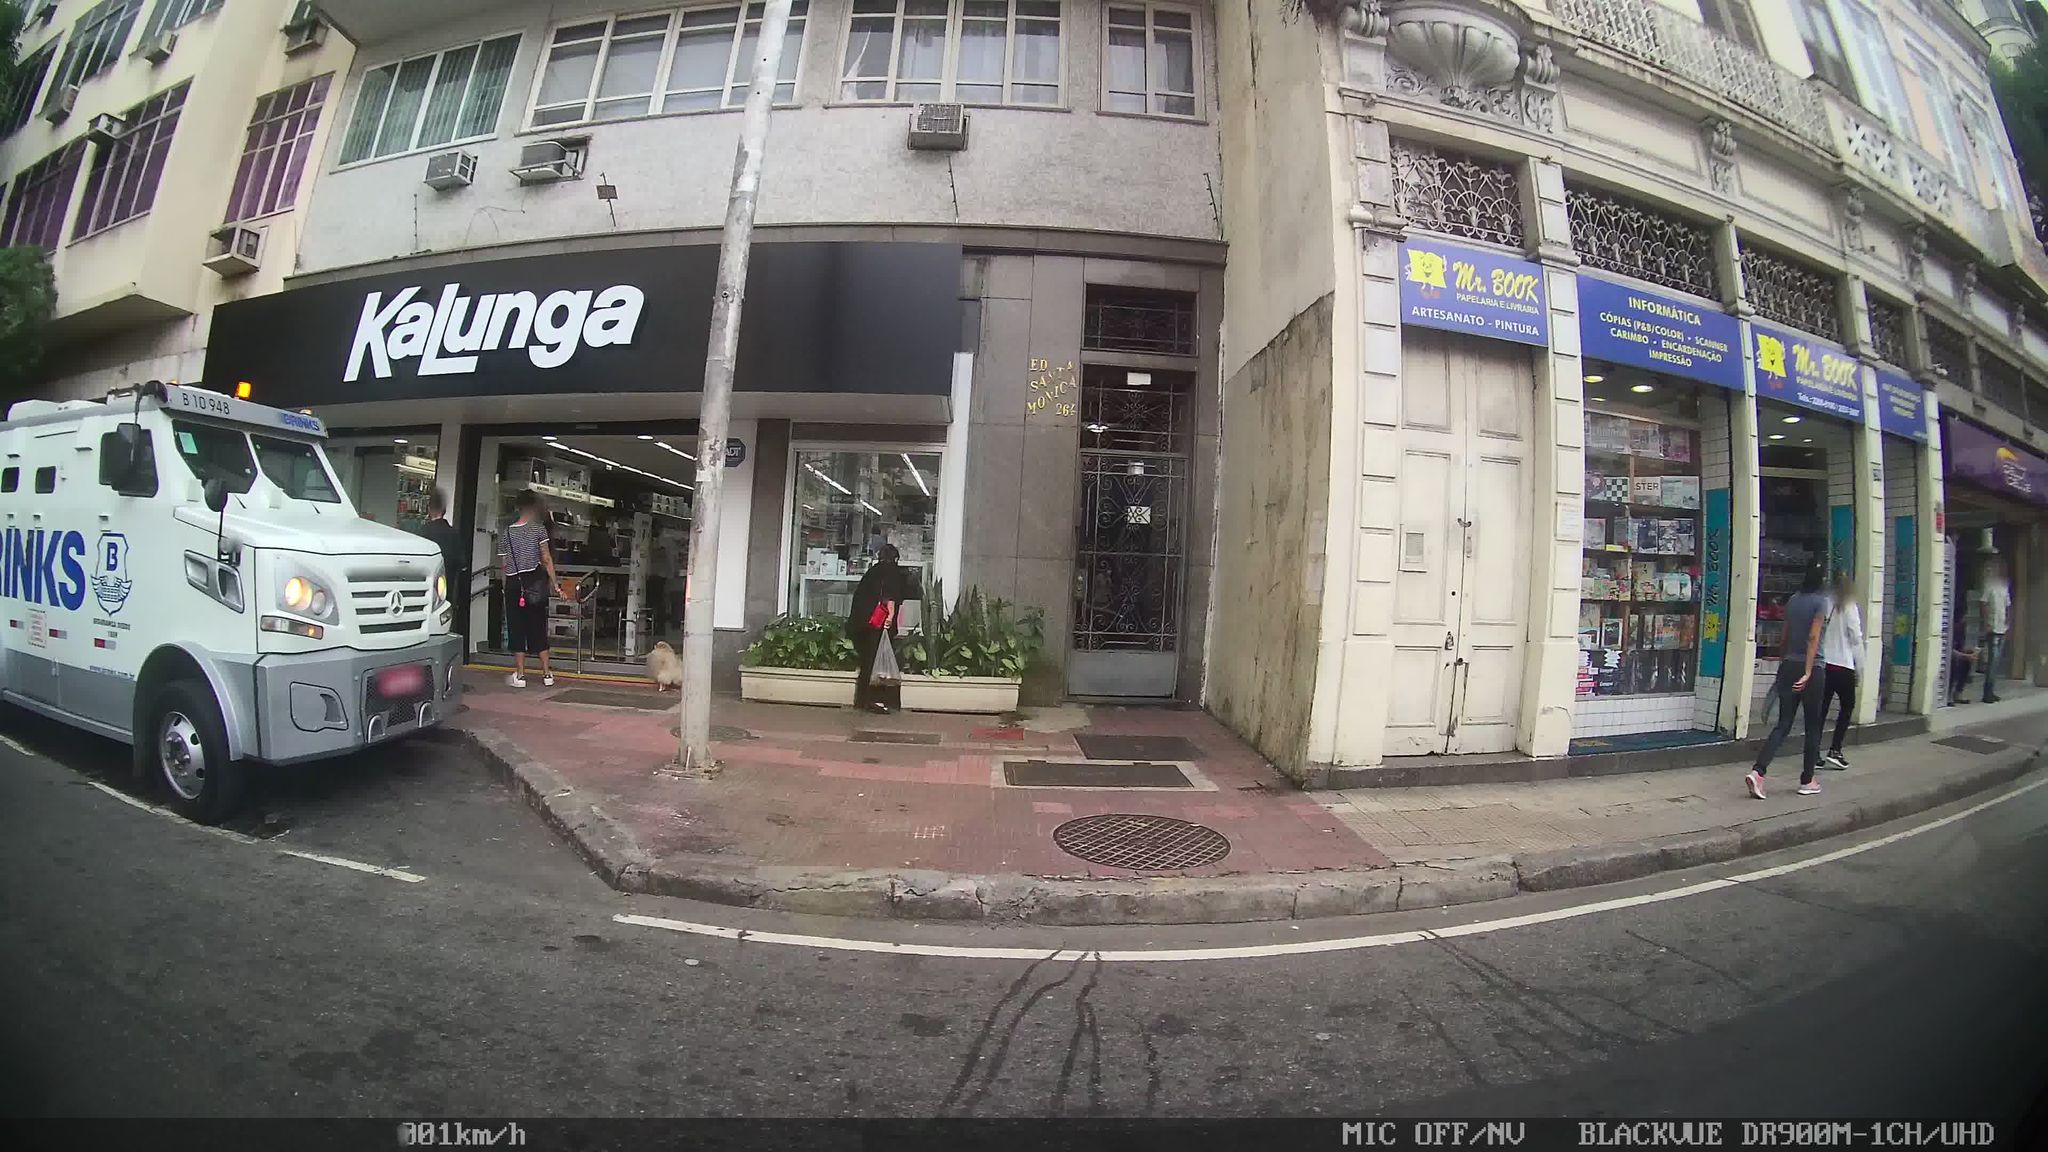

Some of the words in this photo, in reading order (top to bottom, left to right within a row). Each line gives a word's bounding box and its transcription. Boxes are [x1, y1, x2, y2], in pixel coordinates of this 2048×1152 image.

[1453, 261, 1486, 293] Mr.
[1491, 269, 1539, 303] BOOK
[1456, 292, 1498, 308] PAPELARIA
[1506, 301, 1539, 315] LIVRARIA
[1628, 296, 1702, 326] INFORMÁTICA
[1411, 306, 1484, 326] ARTESANATO
[1495, 319, 1539, 336] PINTURA
[1599, 311, 1632, 328] CÓPIAS
[1610, 327, 1649, 344] CARIMBO
[1029, 358, 1048, 372] ED
[1649, 349, 1692, 367] IMPRESSÃO
[1821, 353, 1858, 392] BOOK
[182, 393, 189, 406] B
[0, 527, 86, 611] INKS
[106, 541, 118, 571] B
